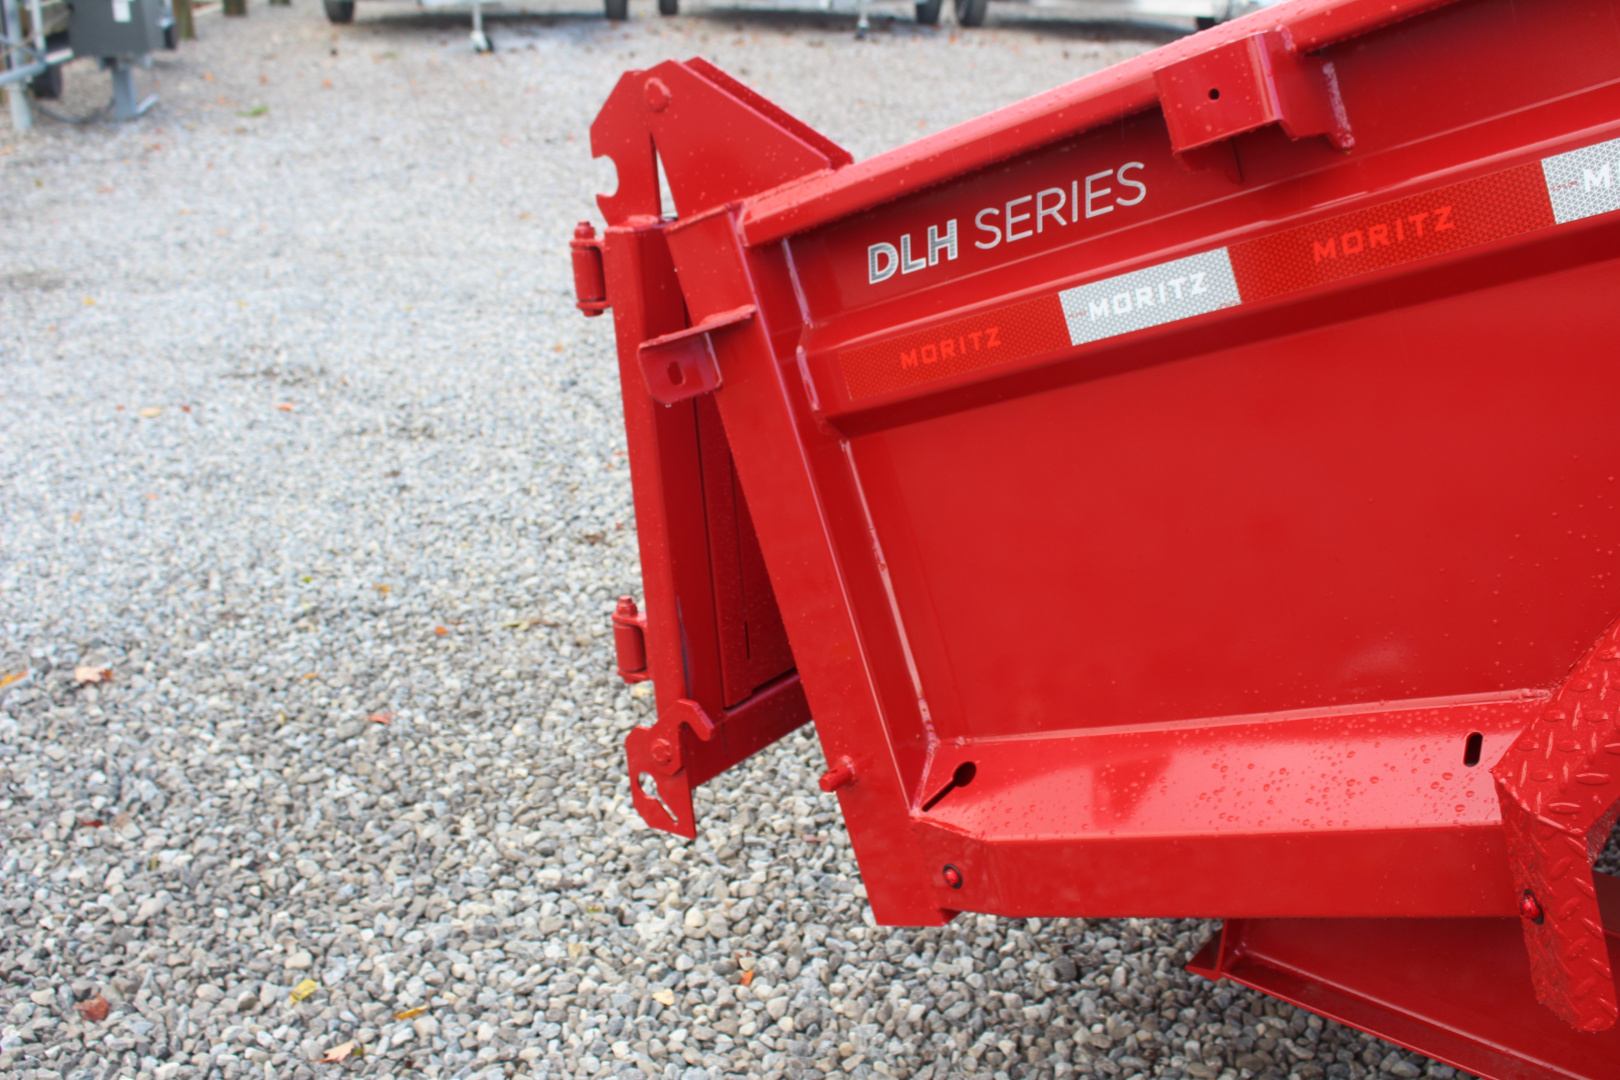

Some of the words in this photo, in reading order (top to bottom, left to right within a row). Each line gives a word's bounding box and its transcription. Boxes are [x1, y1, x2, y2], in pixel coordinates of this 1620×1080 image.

[1583, 163, 1620, 192] M
[867, 219, 959, 285] DLH
[974, 162, 1147, 250] SERIES
[1312, 206, 1454, 263] MORITZ
[1088, 271, 1208, 323] MORITZ
[900, 327, 1002, 370] MORITZ
